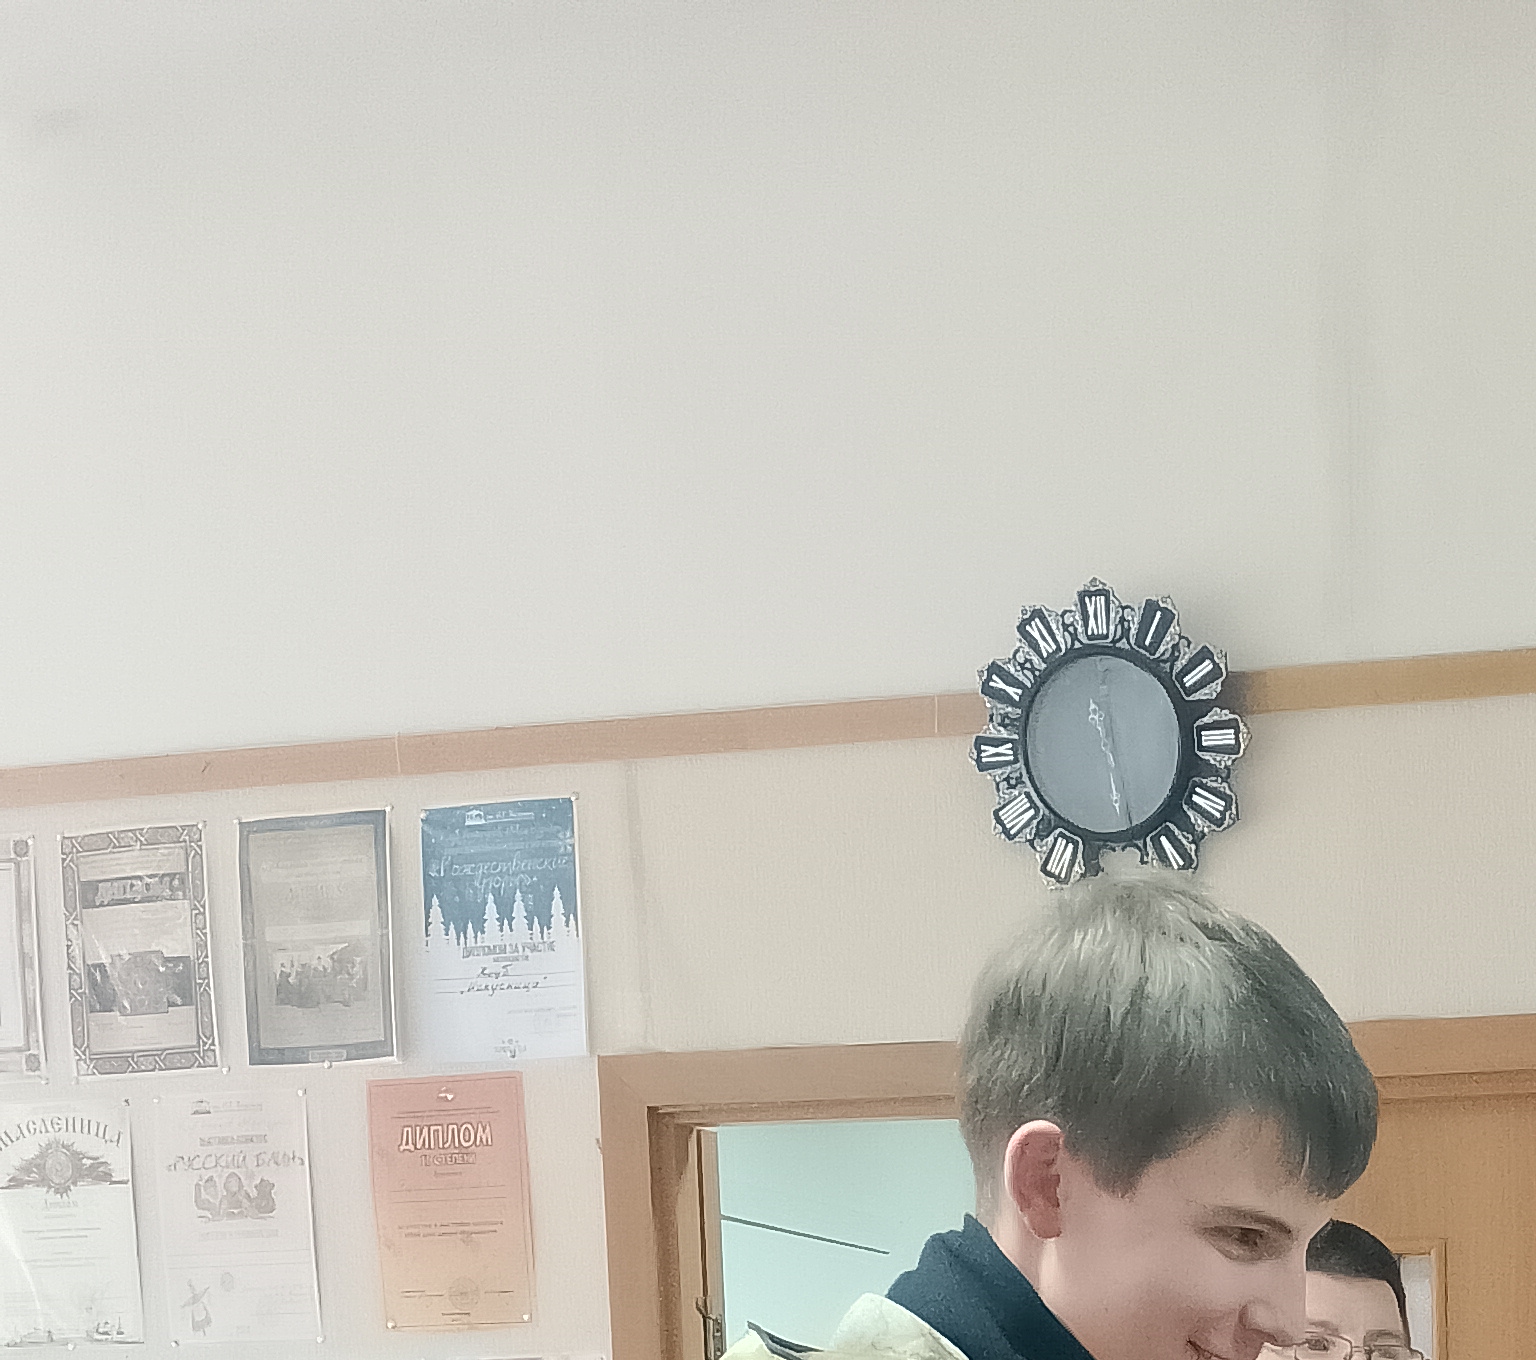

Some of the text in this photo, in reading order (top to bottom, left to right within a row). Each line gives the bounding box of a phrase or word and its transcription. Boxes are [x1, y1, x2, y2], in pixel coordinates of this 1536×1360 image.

[1084, 595, 1108, 636] XII
[1025, 617, 1057, 658] XI
[988, 674, 1023, 702] X
[1182, 658, 1214, 688] II
[1200, 728, 1235, 747] III
[398, 1121, 493, 1153] ДИПЛОМ
